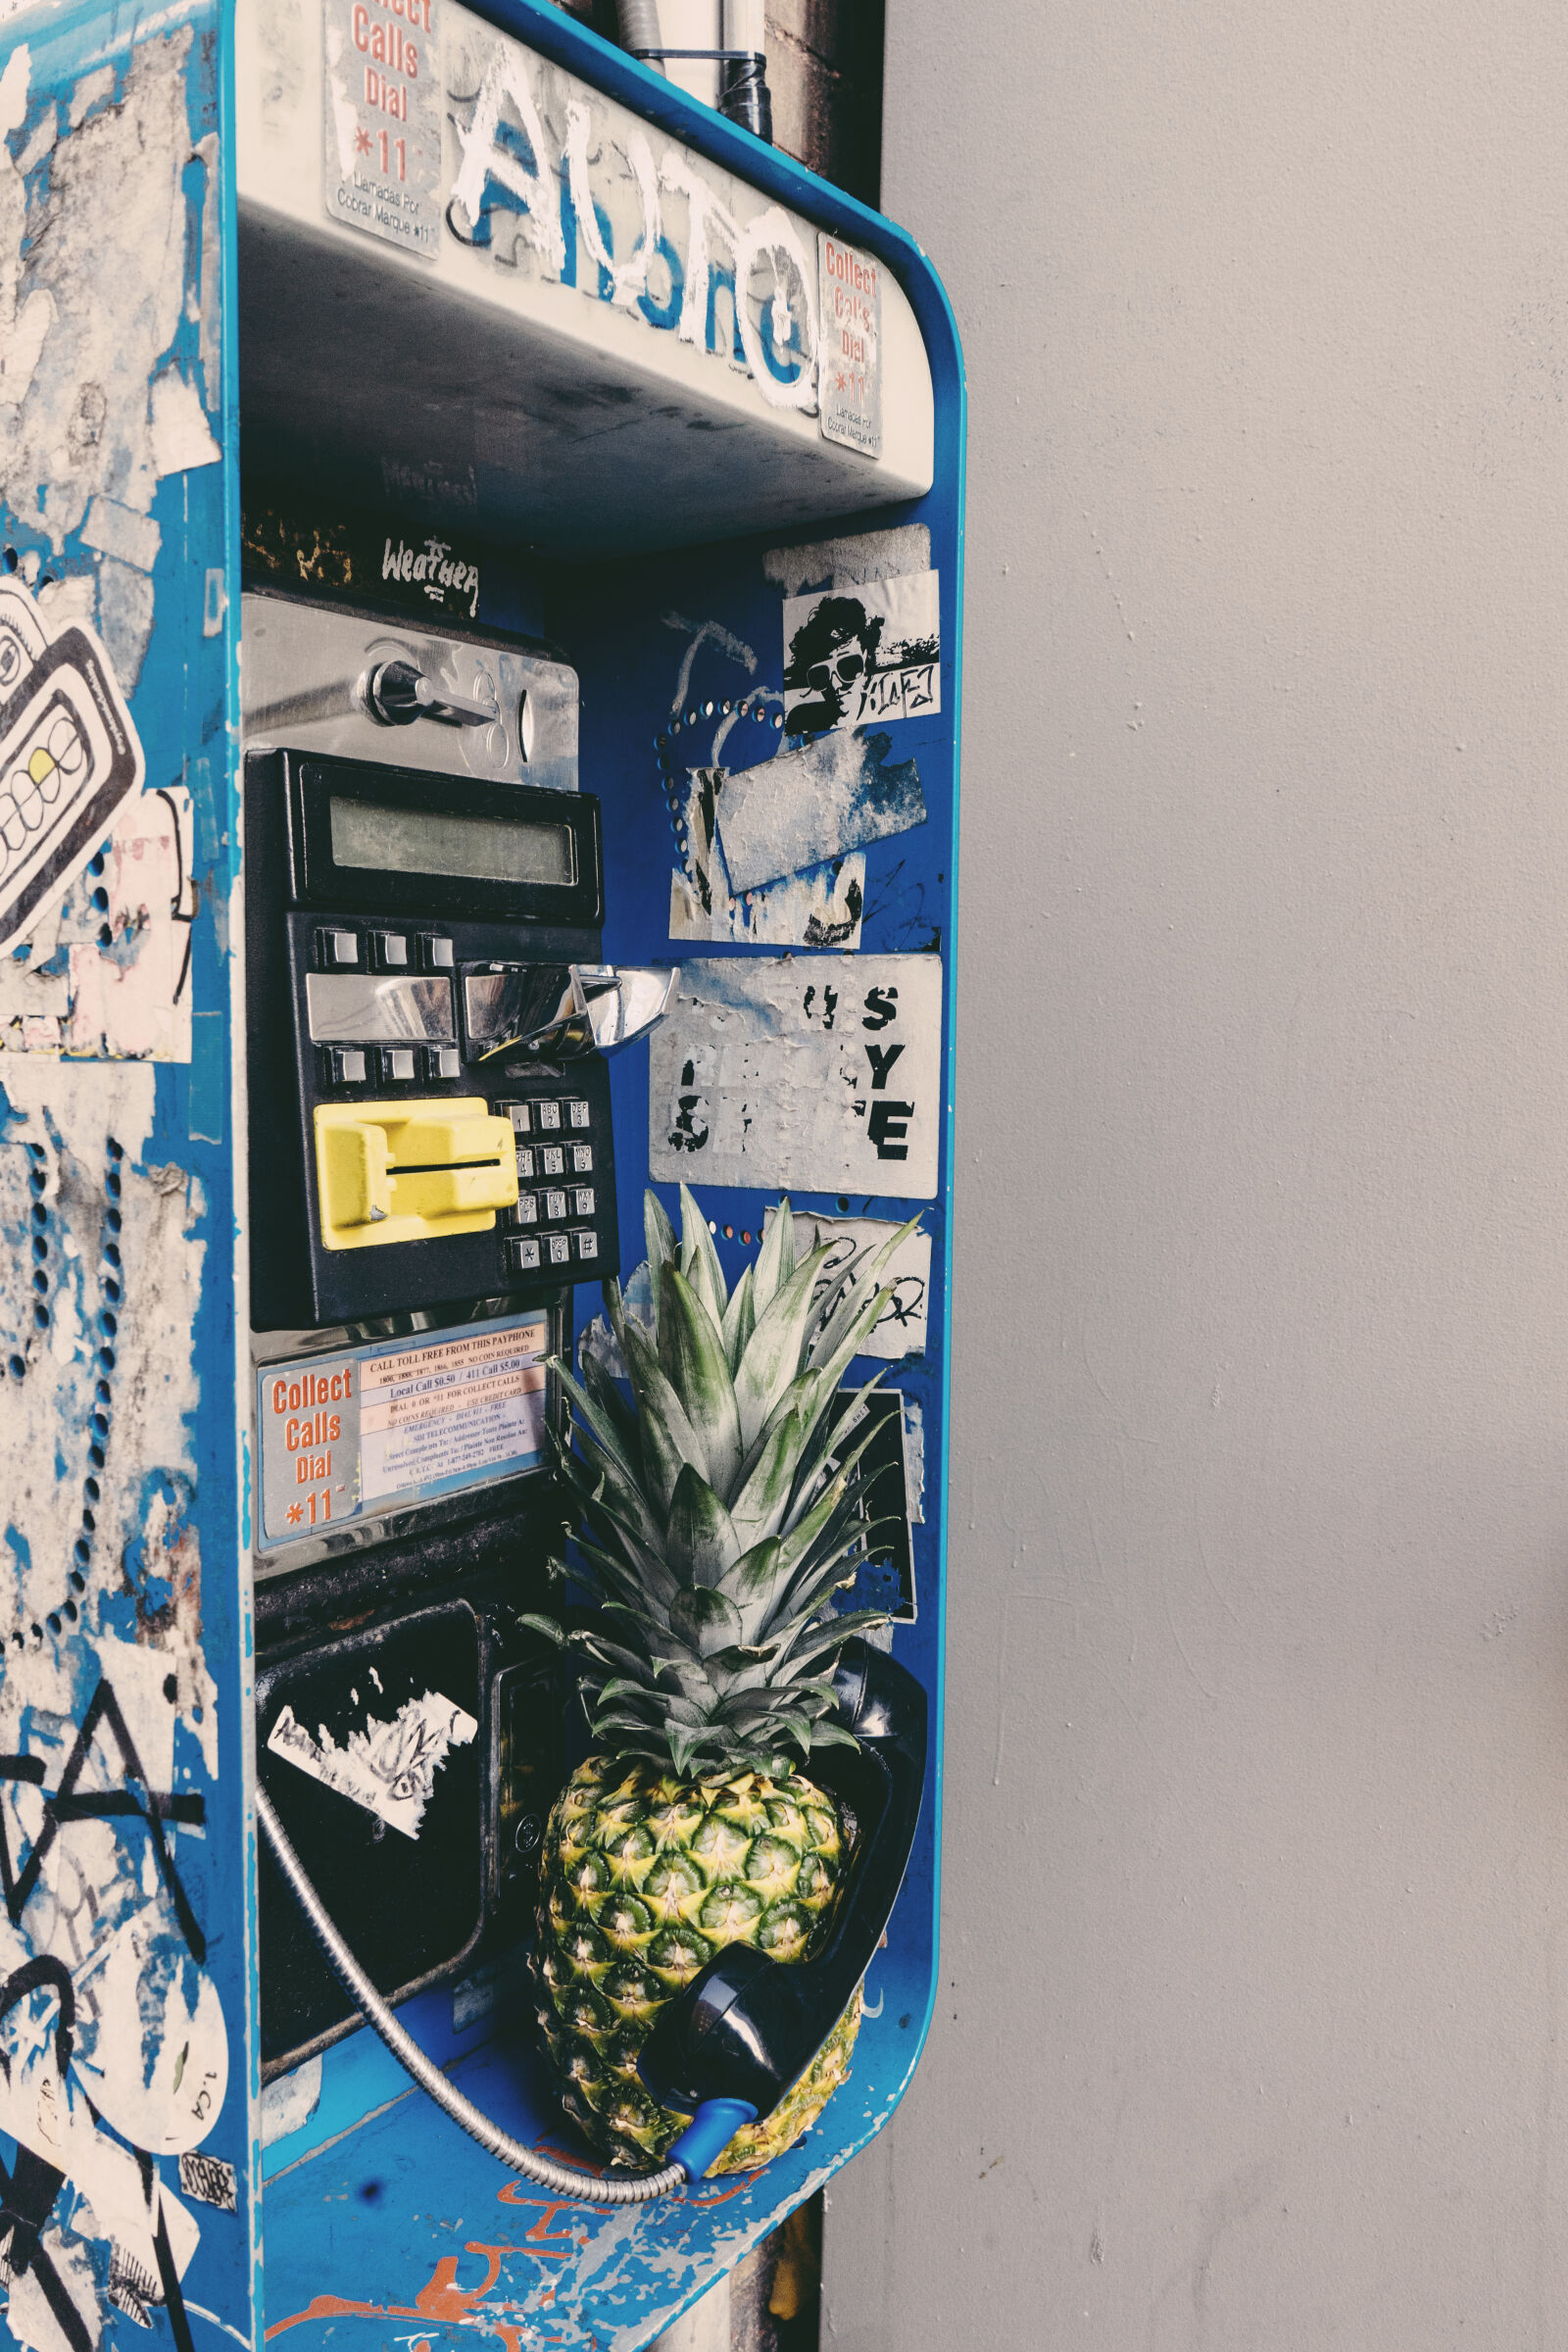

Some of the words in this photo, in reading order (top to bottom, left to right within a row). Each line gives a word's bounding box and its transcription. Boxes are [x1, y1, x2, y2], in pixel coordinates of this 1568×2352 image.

[353, 3, 418, 78] Calls
[366, 66, 407, 122] Dial
[337, 187, 372, 217] Cobrar
[374, 203, 410, 234] Marque
[403, 194, 419, 215] Por
[826, 242, 876, 298] Collect
[543, 1104, 558, 1114] ABC
[572, 1102, 587, 1113] DEF
[548, 1116, 555, 1127] 2
[577, 1114, 582, 1126] 3
[546, 1149, 562, 1160] JKL
[575, 1147, 590, 1157] MNO
[520, 1163, 526, 1175] 4
[551, 1161, 557, 1172] 5
[550, 1194, 564, 1204] TUV
[583, 1202, 588, 1213] 9
[524, 1209, 531, 1223] 7
[555, 1205, 560, 1216] 8
[557, 1250, 563, 1260] 0
[369, 1359, 394, 1372] CALL
[396, 1353, 420, 1366] TOLL
[421, 1348, 443, 1361] FREE
[445, 1343, 468, 1355] FROM
[471, 1338, 490, 1349] THIS
[492, 1328, 534, 1345] PAYPHONE
[478, 1351, 494, 1361] COIN
[496, 1344, 529, 1357] REQUIRED
[390, 1384, 413, 1397] Local
[416, 1379, 431, 1392] Call
[434, 1373, 455, 1387] $0.50
[466, 1368, 478, 1379] 411
[482, 1363, 497, 1375] Call
[500, 1358, 519, 1371] $5.00
[272, 1368, 353, 1414] Collect
[418, 1396, 429, 1405] OR
[447, 1389, 462, 1398] FOR
[463, 1381, 494, 1395] COLLECT
[497, 1374, 519, 1386] CALLS
[404, 1416, 445, 1434] EMERGENCY
[490, 1400, 506, 1411] FREE
[426, 1412, 500, 1439] TELECOMMUNICATION
[285, 1411, 341, 1451] Calls
[296, 1449, 331, 1484] Dial
